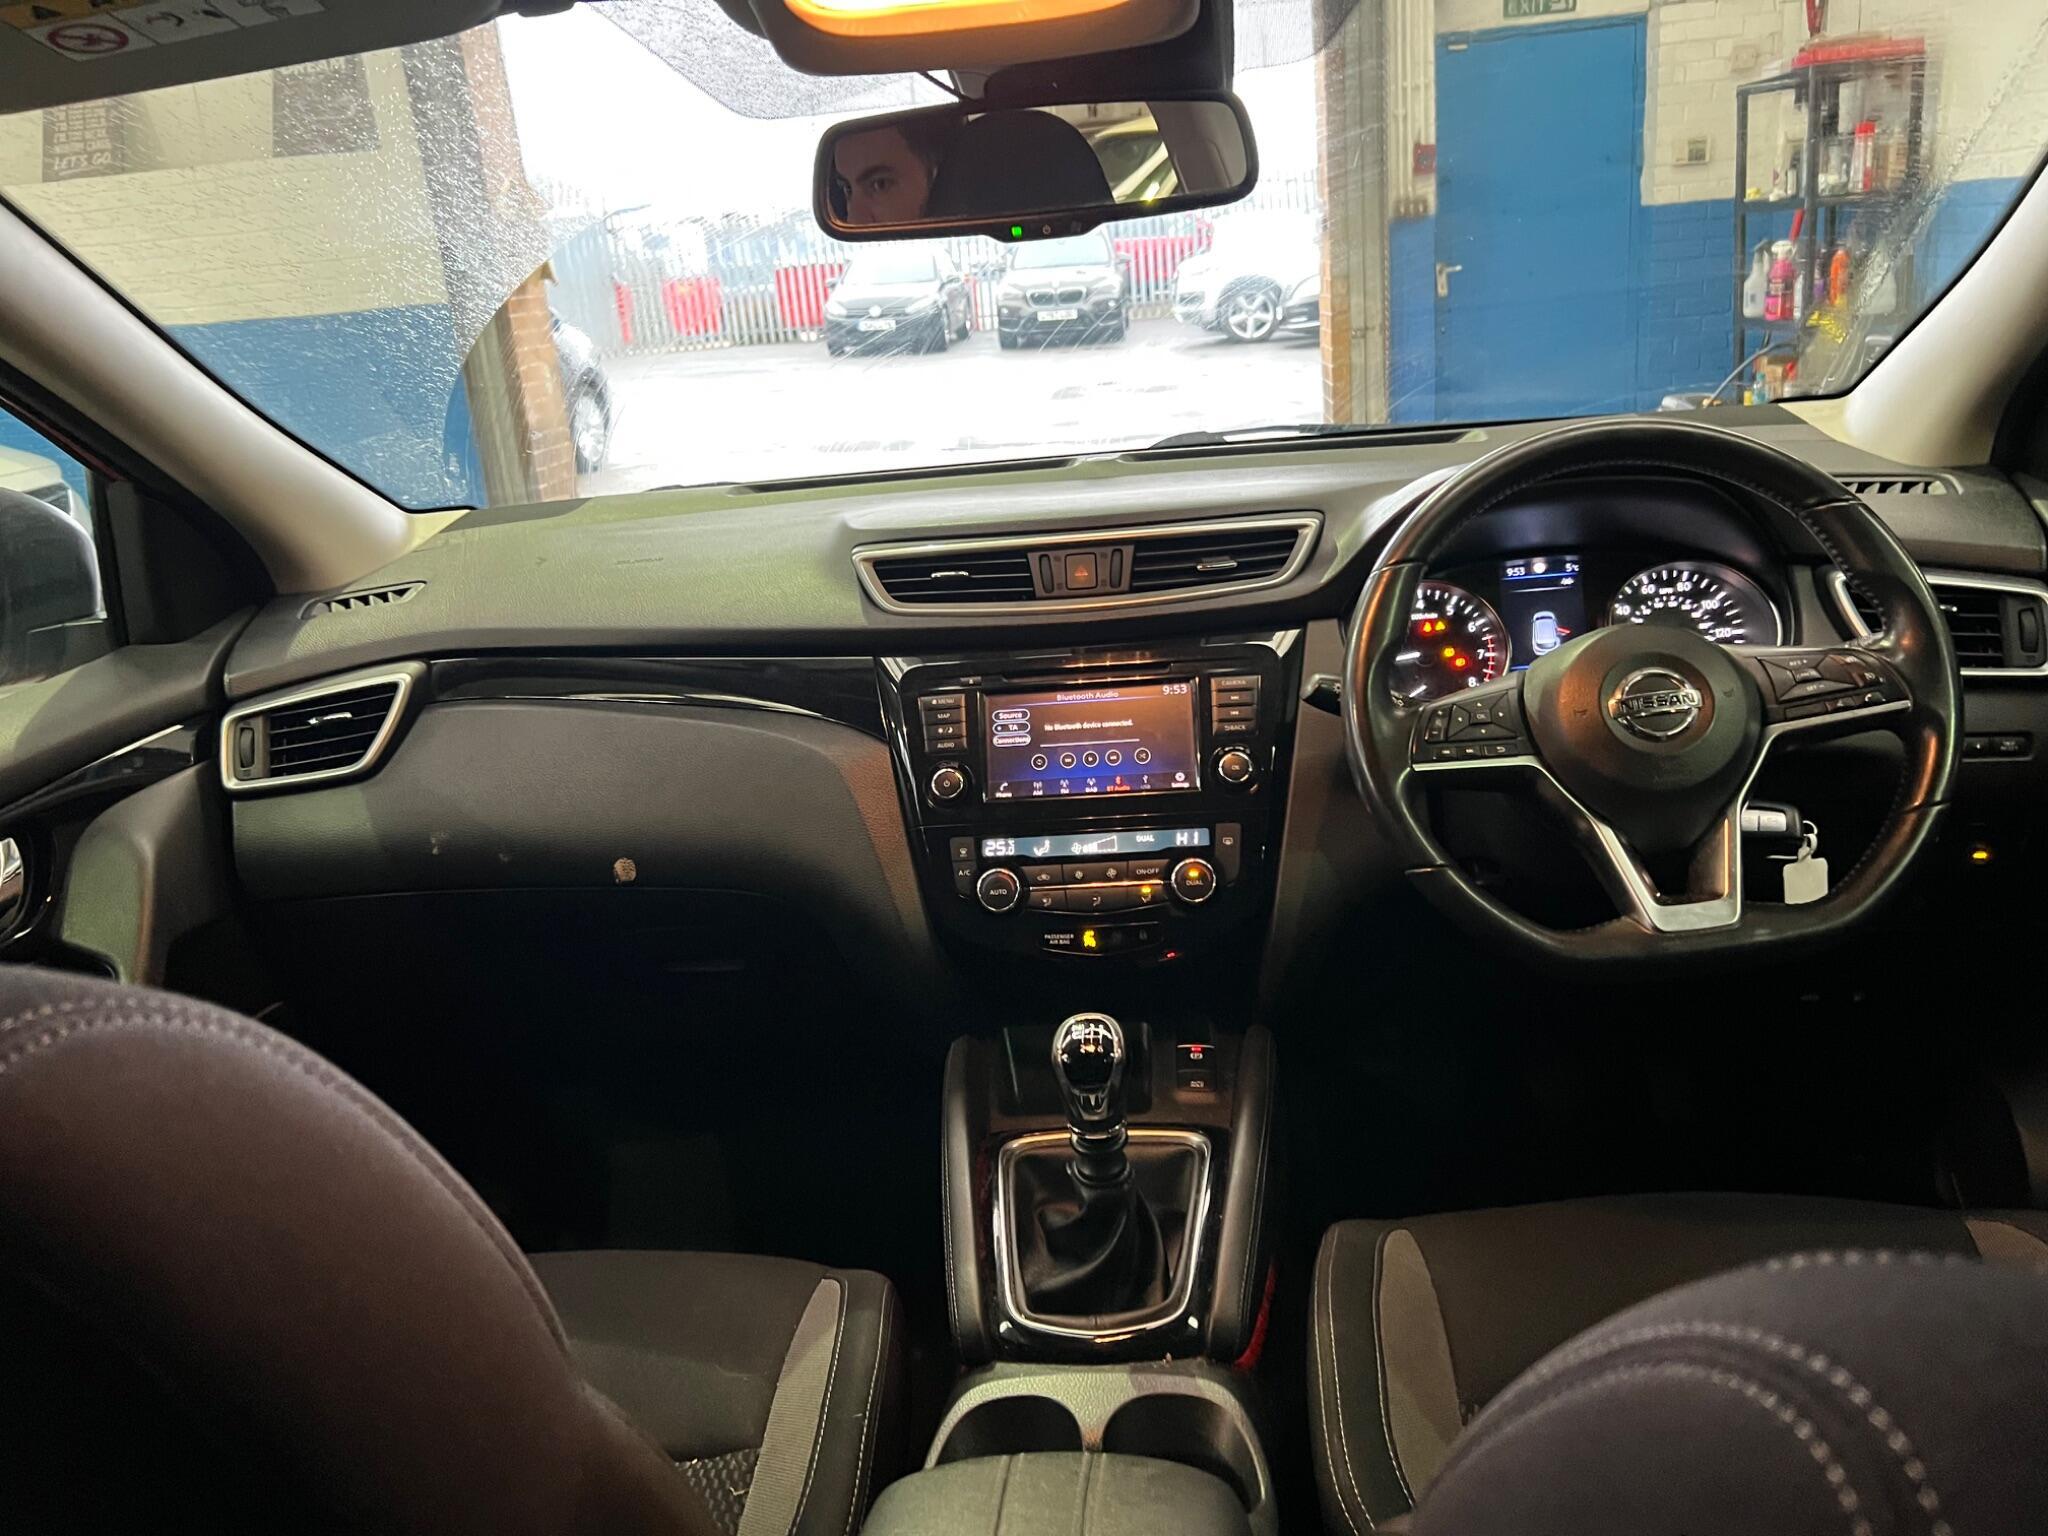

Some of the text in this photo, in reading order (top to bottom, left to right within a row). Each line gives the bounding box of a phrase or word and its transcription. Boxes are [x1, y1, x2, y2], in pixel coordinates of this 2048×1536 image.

[54, 152, 111, 170] LET'S GO
[1641, 584, 1656, 595] 60
[1676, 582, 1692, 592] 80
[1416, 600, 1425, 609] 4
[1701, 600, 1720, 610] 100
[1446, 606, 1454, 616] 5
[1616, 605, 1631, 616] 40
[1467, 623, 1476, 632] 6
[1714, 628, 1732, 638] 120
[1477, 650, 1486, 660] 7
[1468, 676, 1477, 688] 8
[1162, 684, 1188, 695] 9:53
[1056, 690, 1119, 702] Bluetooth Audio
[1619, 690, 1699, 714] NISSAN
[998, 711, 1023, 720] Source
[1008, 724, 1019, 732] TA
[1083, 721, 1101, 729] device
[1136, 834, 1155, 843] DUAL
[958, 868, 971, 877] A/C
[1185, 879, 1204, 887] DUAL
[989, 888, 1008, 896] AUTO
